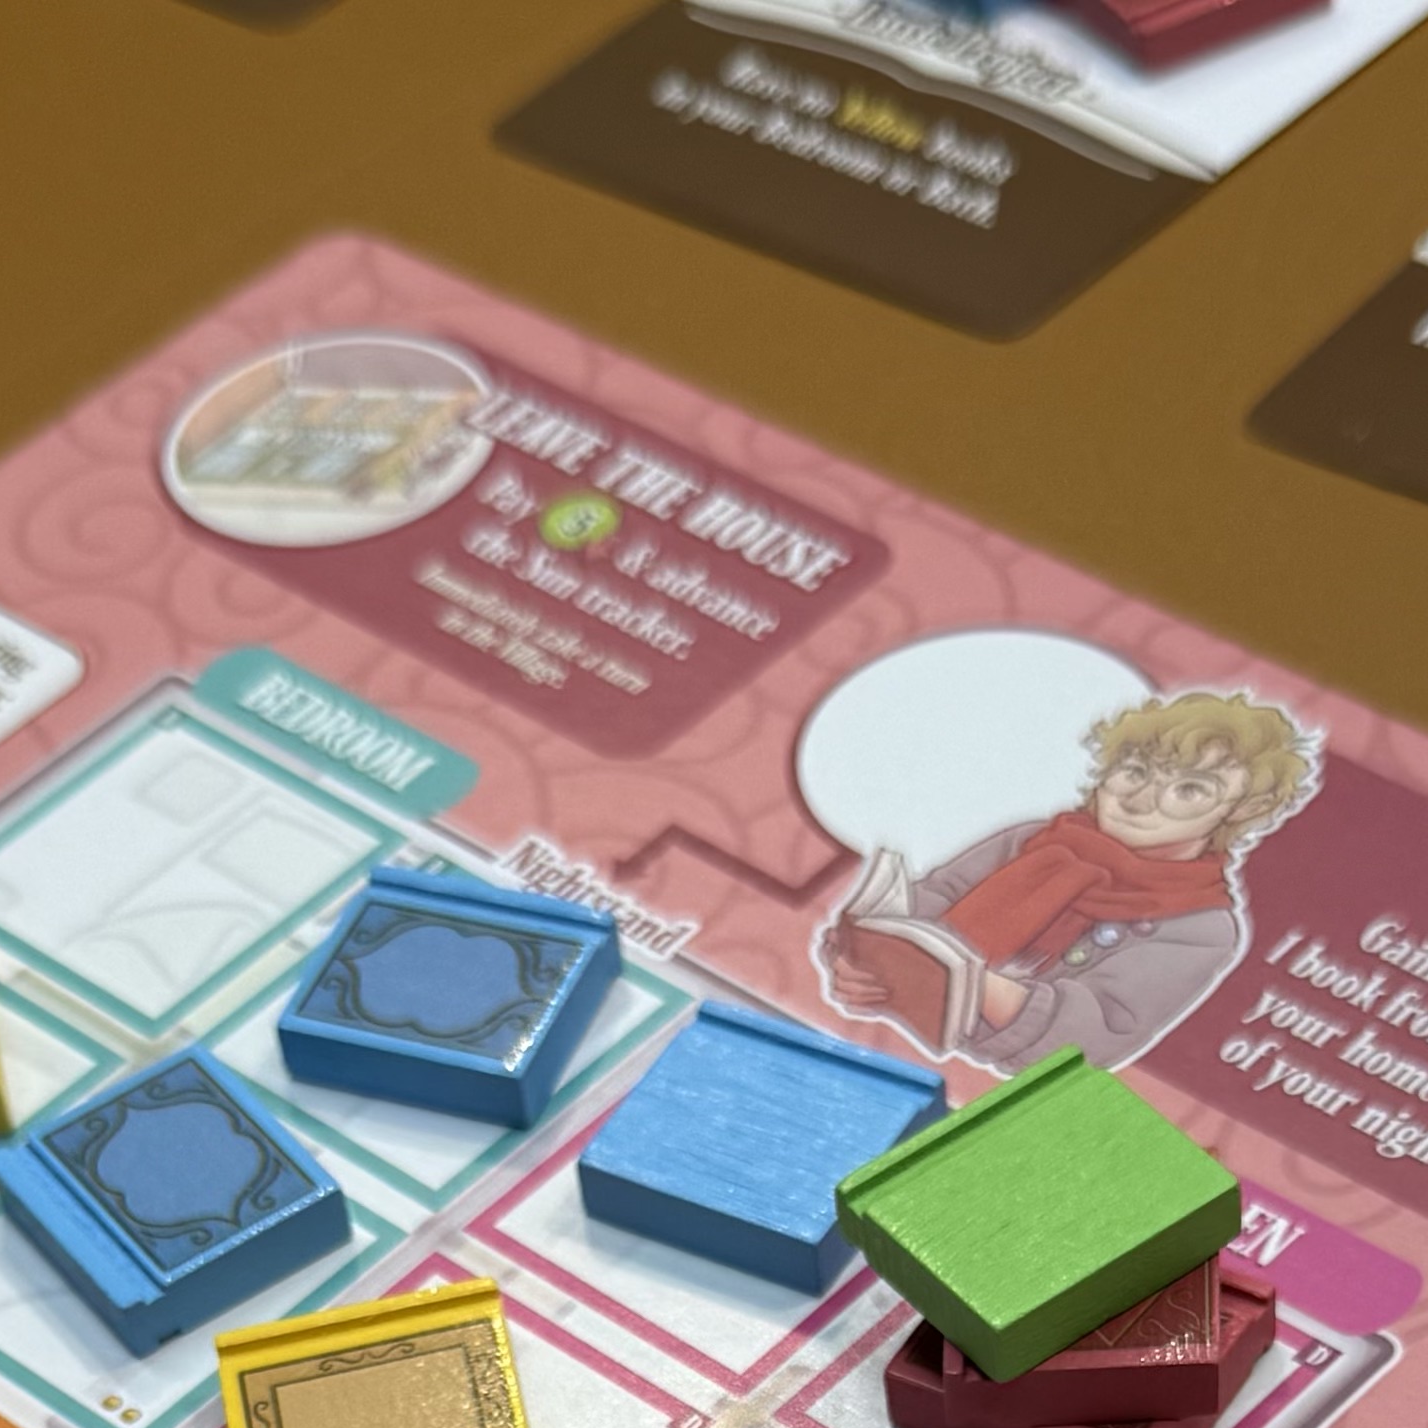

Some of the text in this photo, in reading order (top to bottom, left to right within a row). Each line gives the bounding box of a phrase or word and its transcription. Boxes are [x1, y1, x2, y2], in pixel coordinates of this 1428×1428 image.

[467, 392, 853, 592] LEAVE THE HOUSE
[463, 522, 518, 569] the
[515, 544, 581, 600] Sun
[477, 472, 535, 525] Pay
[614, 540, 657, 579] &
[646, 561, 778, 641] advance
[239, 673, 434, 792] BEDROOM
[510, 841, 694, 954] Nightstand
[1242, 988, 1346, 1050] your
[1289, 941, 1385, 1014] book
[1219, 1034, 1280, 1074] of
[1256, 1057, 1361, 1120] your
[1227, 1203, 1306, 1267] EN
